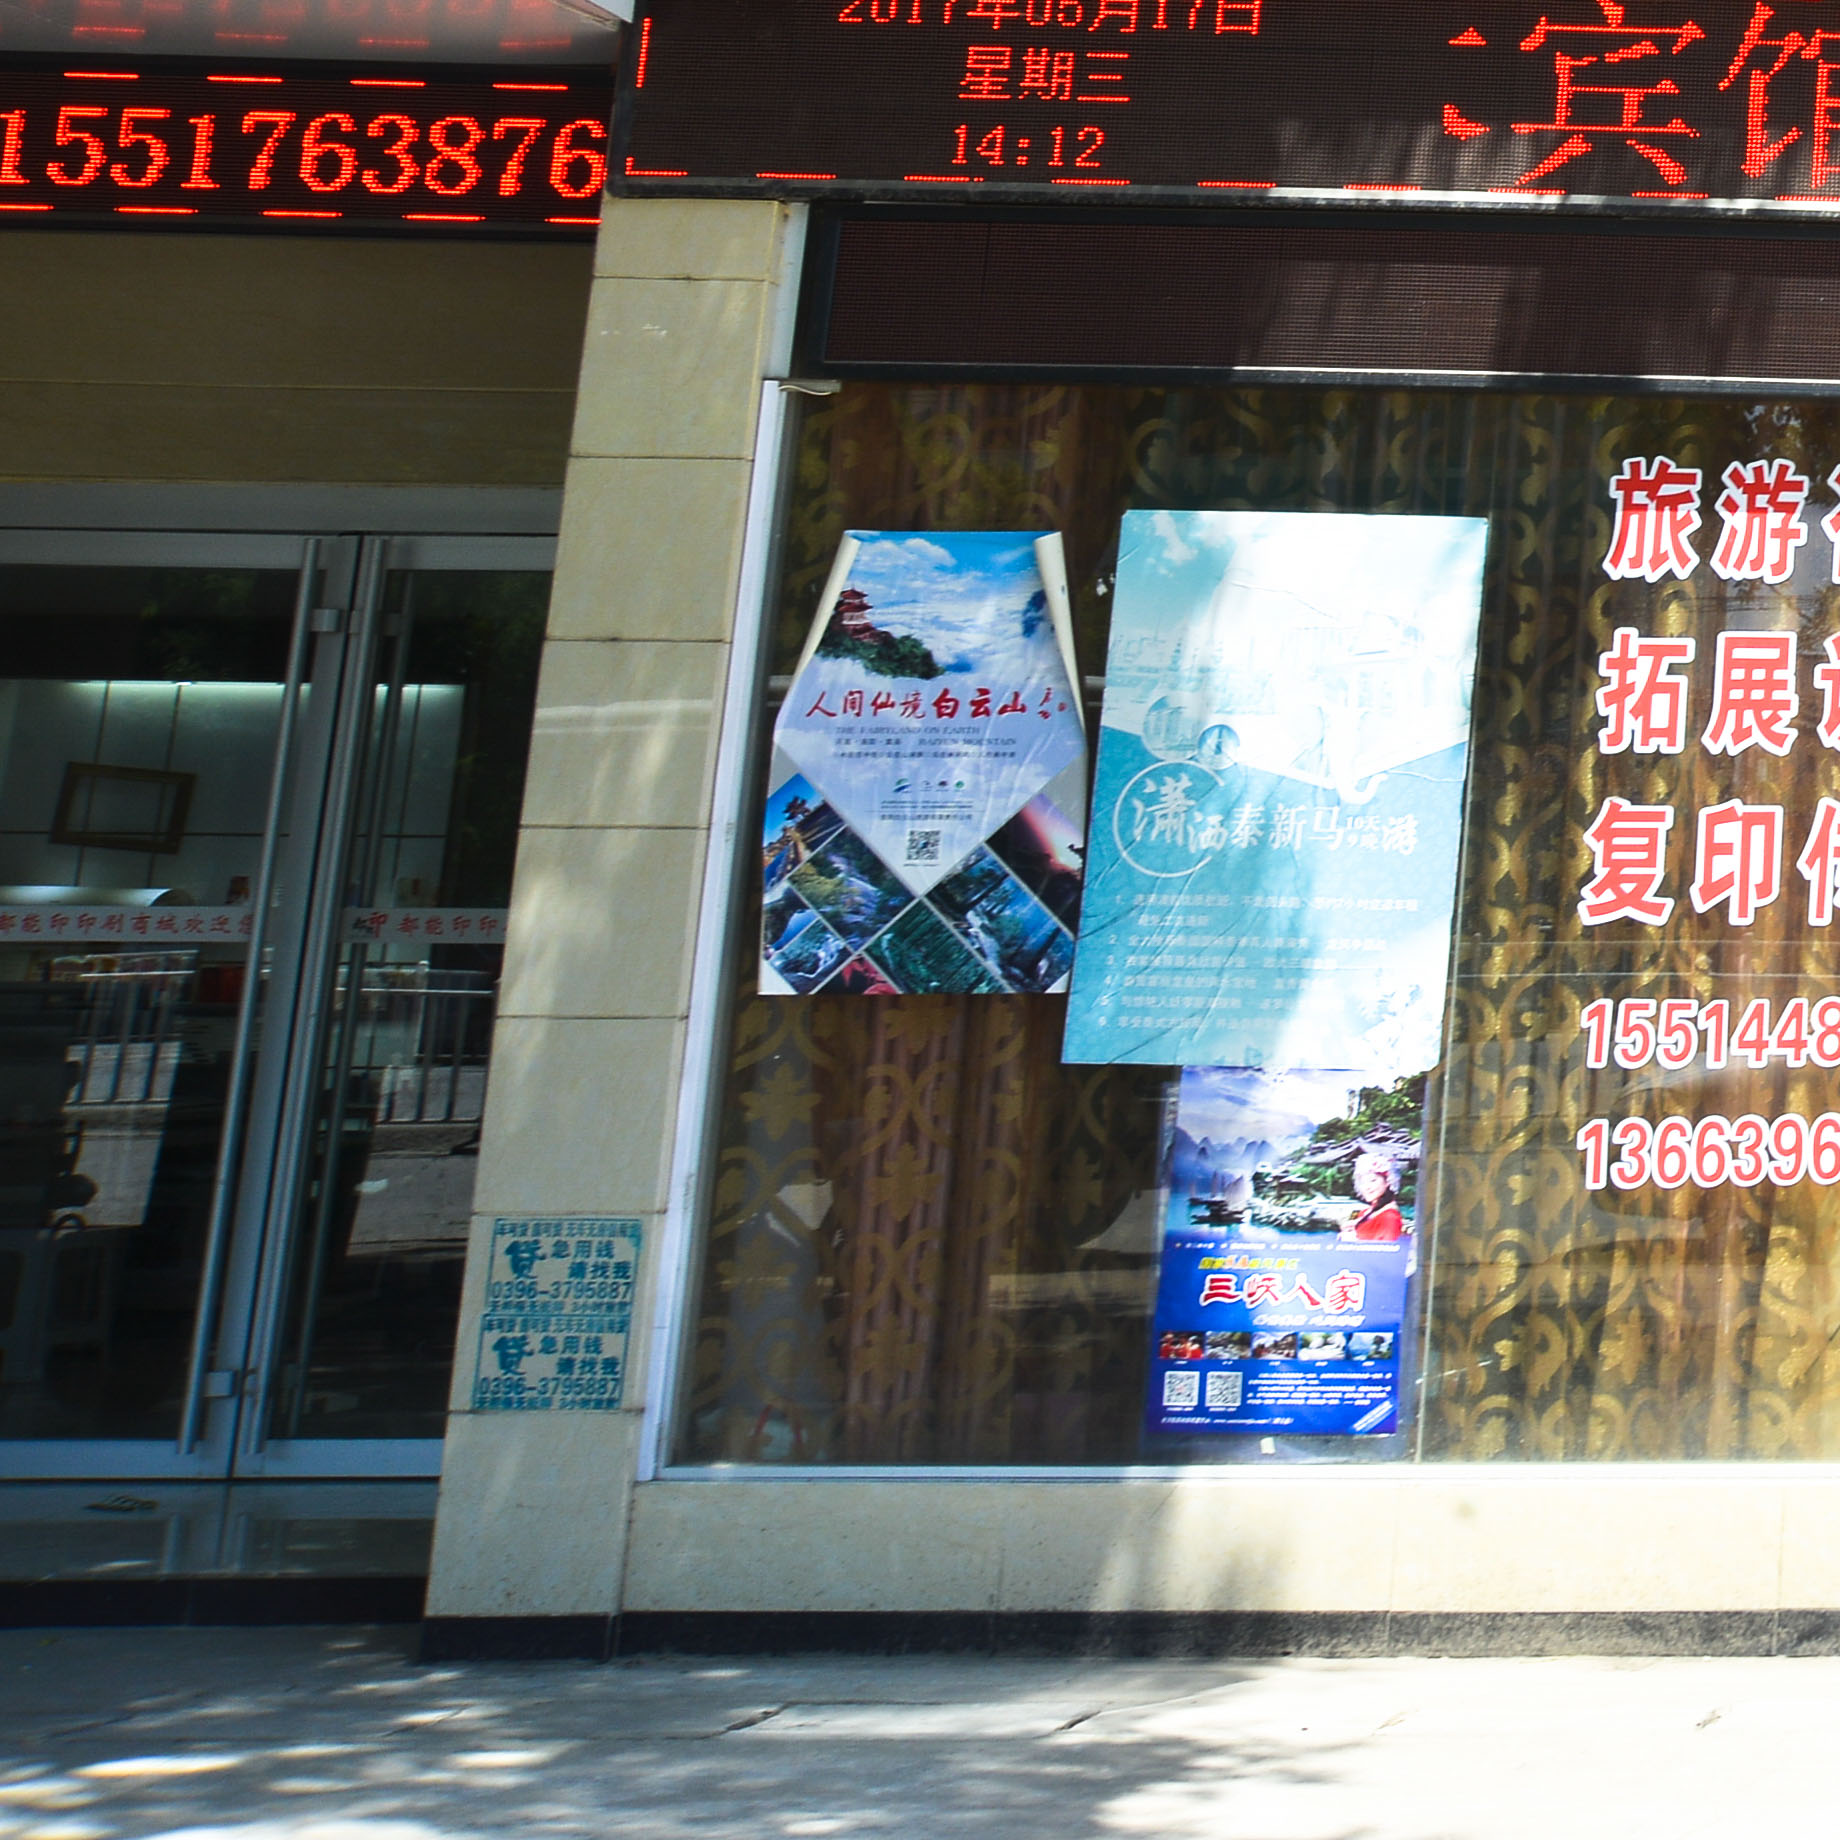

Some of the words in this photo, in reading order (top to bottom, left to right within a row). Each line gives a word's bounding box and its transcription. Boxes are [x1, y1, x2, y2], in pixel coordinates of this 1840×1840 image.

[959, 46, 1130, 102] 星期三
[0, 106, 607, 198] 1551763876
[952, 124, 1106, 168] 14:12
[1200, 1270, 1365, 1314] 三峡人家
